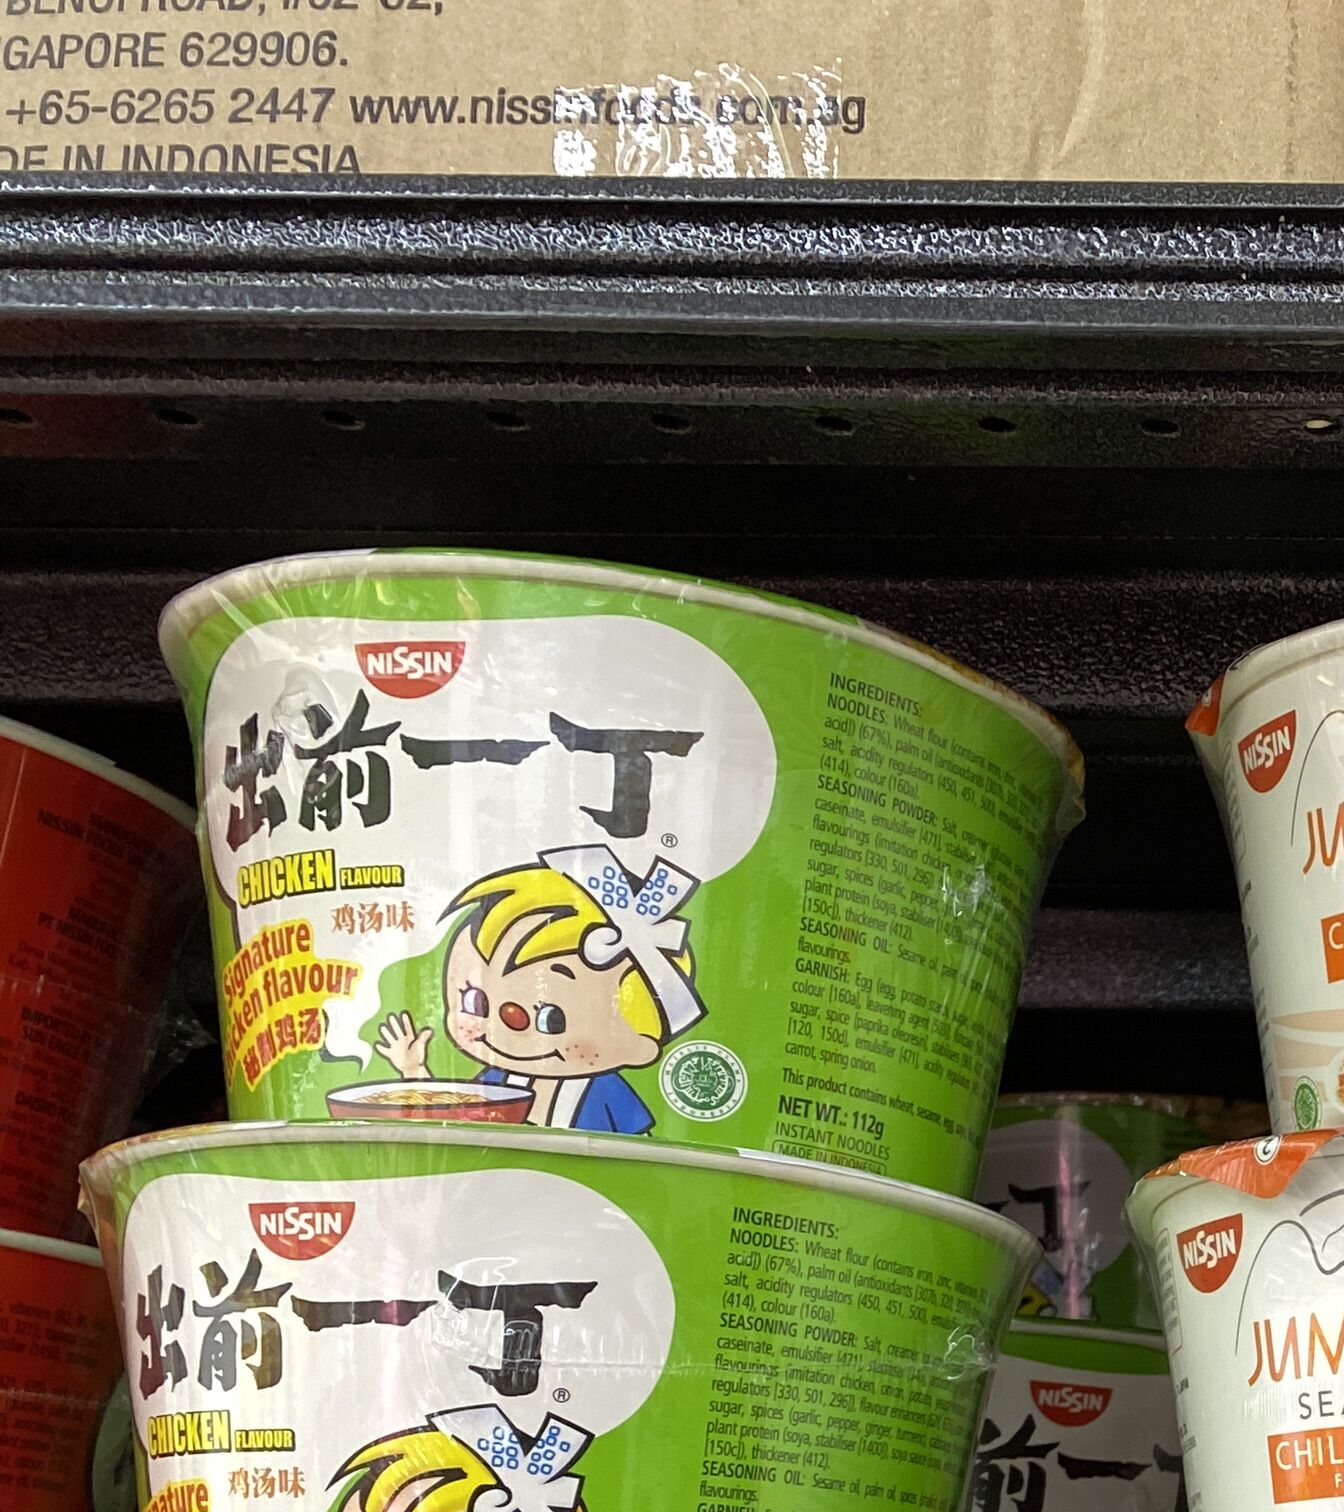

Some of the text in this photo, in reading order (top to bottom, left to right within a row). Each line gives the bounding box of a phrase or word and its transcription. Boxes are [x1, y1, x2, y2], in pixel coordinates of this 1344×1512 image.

[180, 34, 349, 69] 629906.
[5, 88, 214, 126] +65-6265
[229, 88, 332, 124] 2447
[366, 648, 453, 680] NISSIN
[827, 693, 888, 725] NOODLES:
[830, 672, 922, 717] INGREDIENTS:
[1243, 725, 1291, 772] NISSIN
[223, 689, 704, 851] 出前一丁
[237, 850, 404, 906] CHICKEN FLAVOUR
[331, 903, 414, 935] 鸡汤味
[264, 964, 357, 1012] flavour
[852, 1108, 884, 1139] 112g
[260, 1206, 342, 1241] NISSIN
[730, 1228, 798, 1252] NOODLES:
[733, 1206, 839, 1240] INGREDIENTS:
[1183, 1227, 1236, 1269] NISSIN
[137, 1248, 598, 1399] 出前一丁
[720, 1313, 797, 1338] SEASONING
[1039, 1387, 1104, 1412] NISSIN
[148, 1411, 295, 1458] CHICKEN FLAVOUR
[227, 1468, 306, 1498] 鸡汤味
